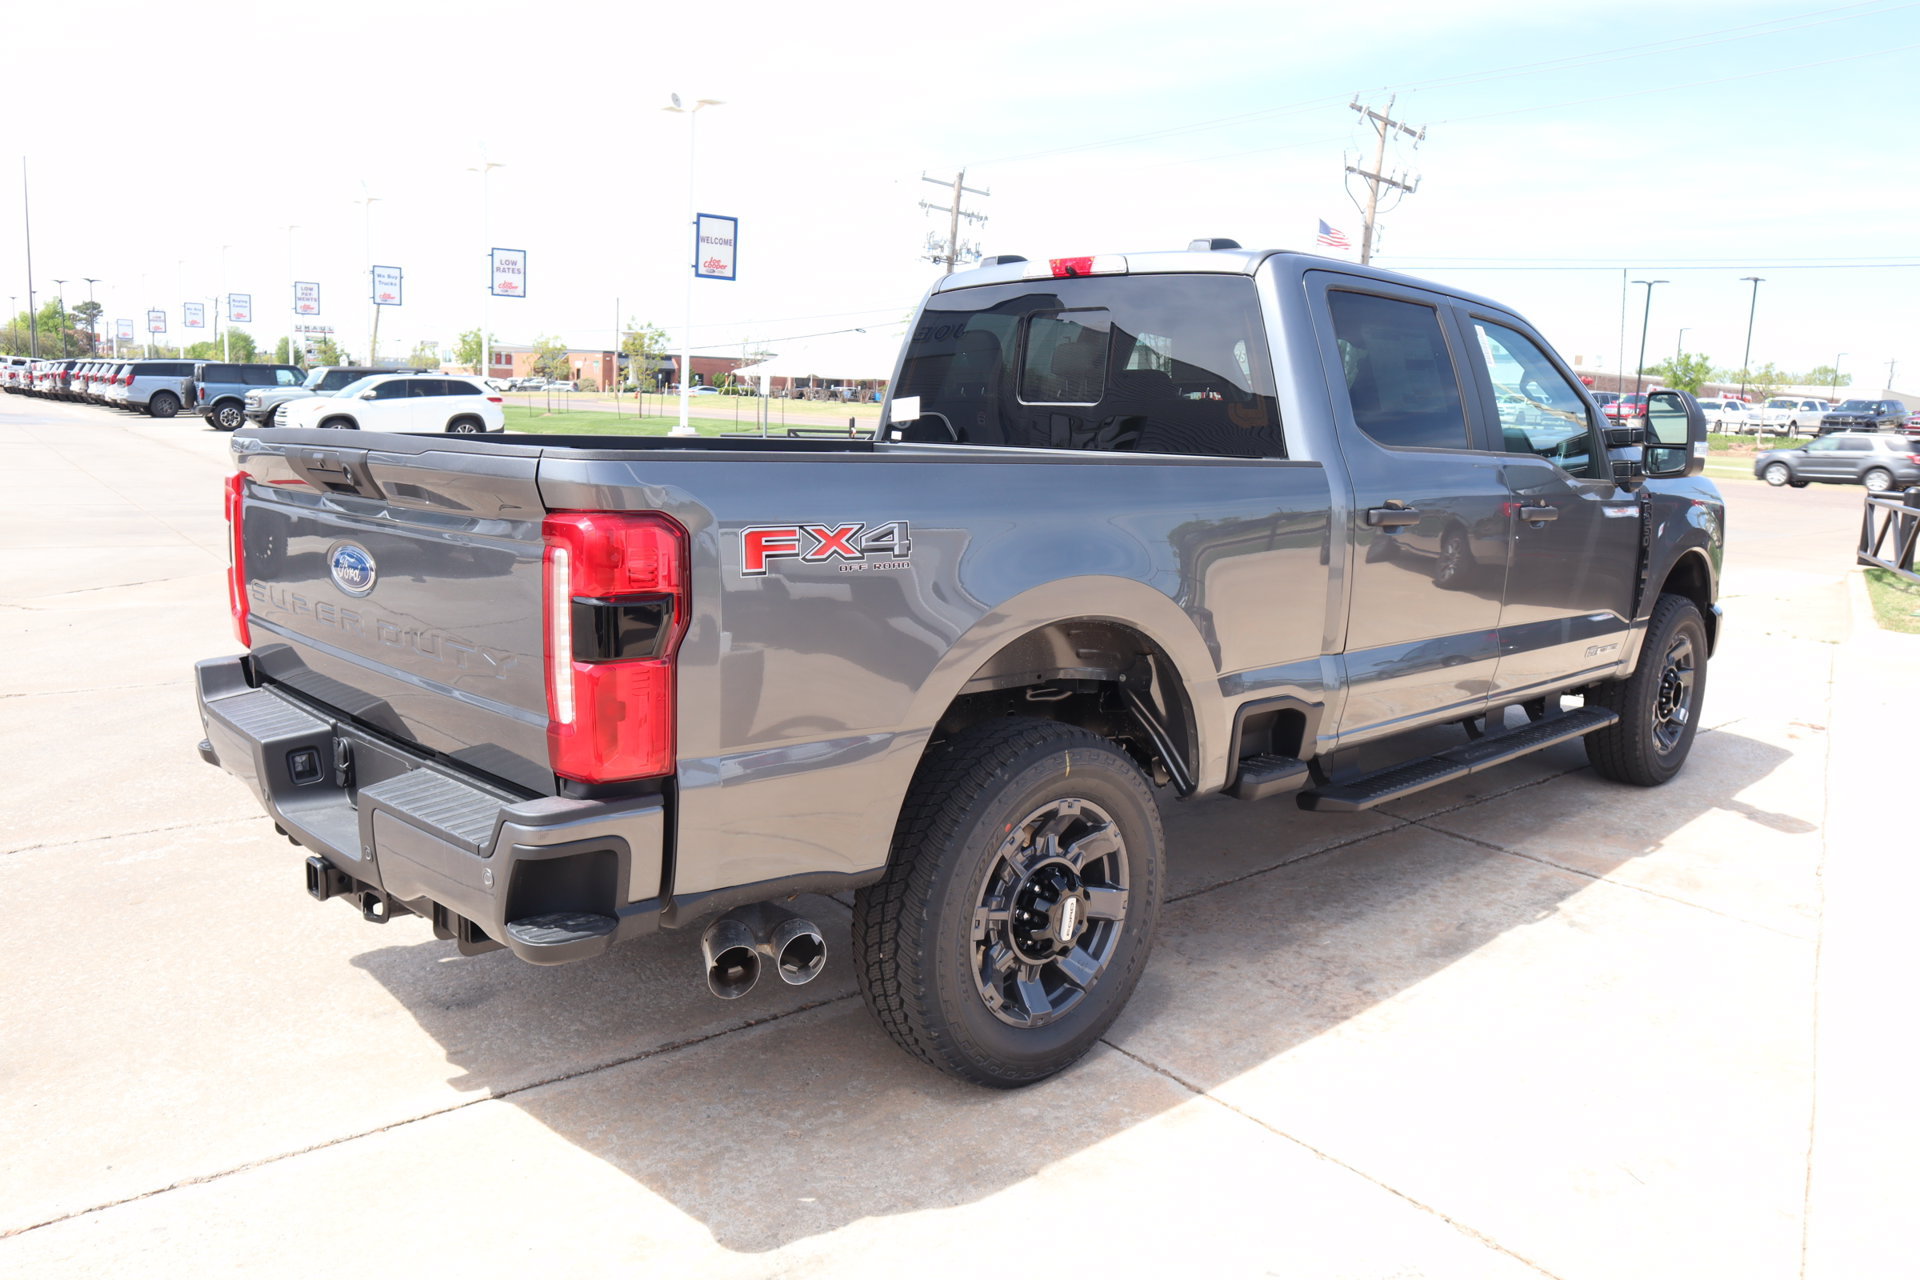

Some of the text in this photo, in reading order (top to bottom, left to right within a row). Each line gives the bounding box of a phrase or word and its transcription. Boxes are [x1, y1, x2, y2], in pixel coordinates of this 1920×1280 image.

[700, 236, 733, 246] WELCOME
[739, 520, 912, 578] FX4
[839, 561, 911, 572] OFF ROAD
[251, 578, 520, 680] SUPER DUTY
